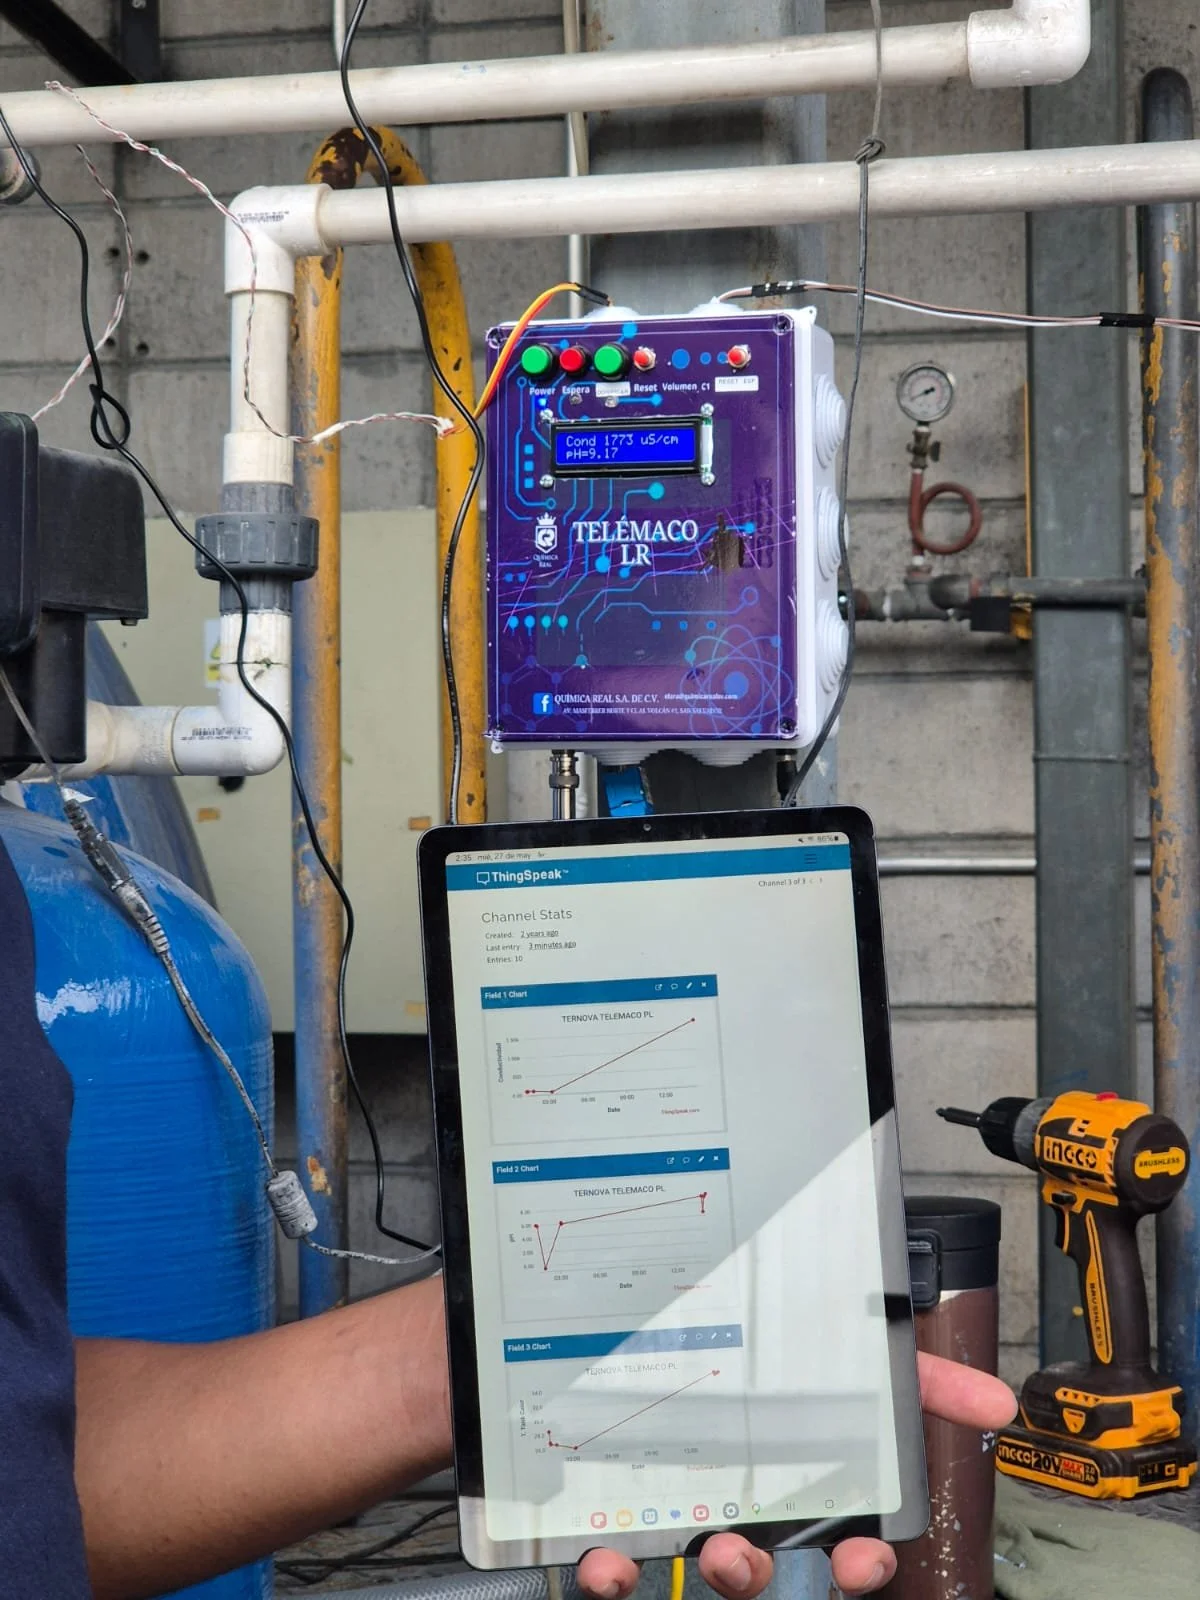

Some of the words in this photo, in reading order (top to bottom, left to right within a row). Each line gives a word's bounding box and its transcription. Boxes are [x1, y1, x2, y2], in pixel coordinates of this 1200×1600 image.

[530, 387, 556, 396] Power
[562, 386, 590, 396] Espera
[634, 384, 658, 392] Reset
[662, 382, 698, 391] Volumen
[701, 382, 710, 390] C1
[566, 436, 596, 447] Cond
[604, 434, 634, 446] 1773
[640, 433, 679, 446] uS/cm
[566, 447, 618, 460] pH=9.17
[572, 516, 699, 542] TELÉMACO
[620, 544, 651, 566] LR
[554, 692, 590, 704] QUÍMICA
[592, 694, 614, 703] REAL
[632, 694, 642, 703] DE
[758, 878, 786, 887] Channel
[481, 910, 537, 924] Channel
[540, 908, 572, 920] Stats
[534, 942, 562, 950] minutes
[484, 991, 501, 1000] Field
[508, 990, 528, 998] Chart
[562, 1014, 598, 1022] TERNOVA
[600, 1012, 642, 1020] TELEMACO
[1138, 1156, 1181, 1168] BRUSHLESS
[496, 1166, 513, 1174] Field
[574, 1187, 610, 1197] TERNOVA
[612, 1185, 654, 1195] TELEMACO
[1090, 1282, 1104, 1346] BRUSHLESS
[508, 1344, 524, 1352] Field
[532, 1342, 551, 1350] Chart
[584, 1366, 622, 1376] TERNOVA
[624, 1363, 666, 1373] TELEMACO
[1033, 1451, 1062, 1476] 20V
[1062, 1459, 1084, 1473] MAX
